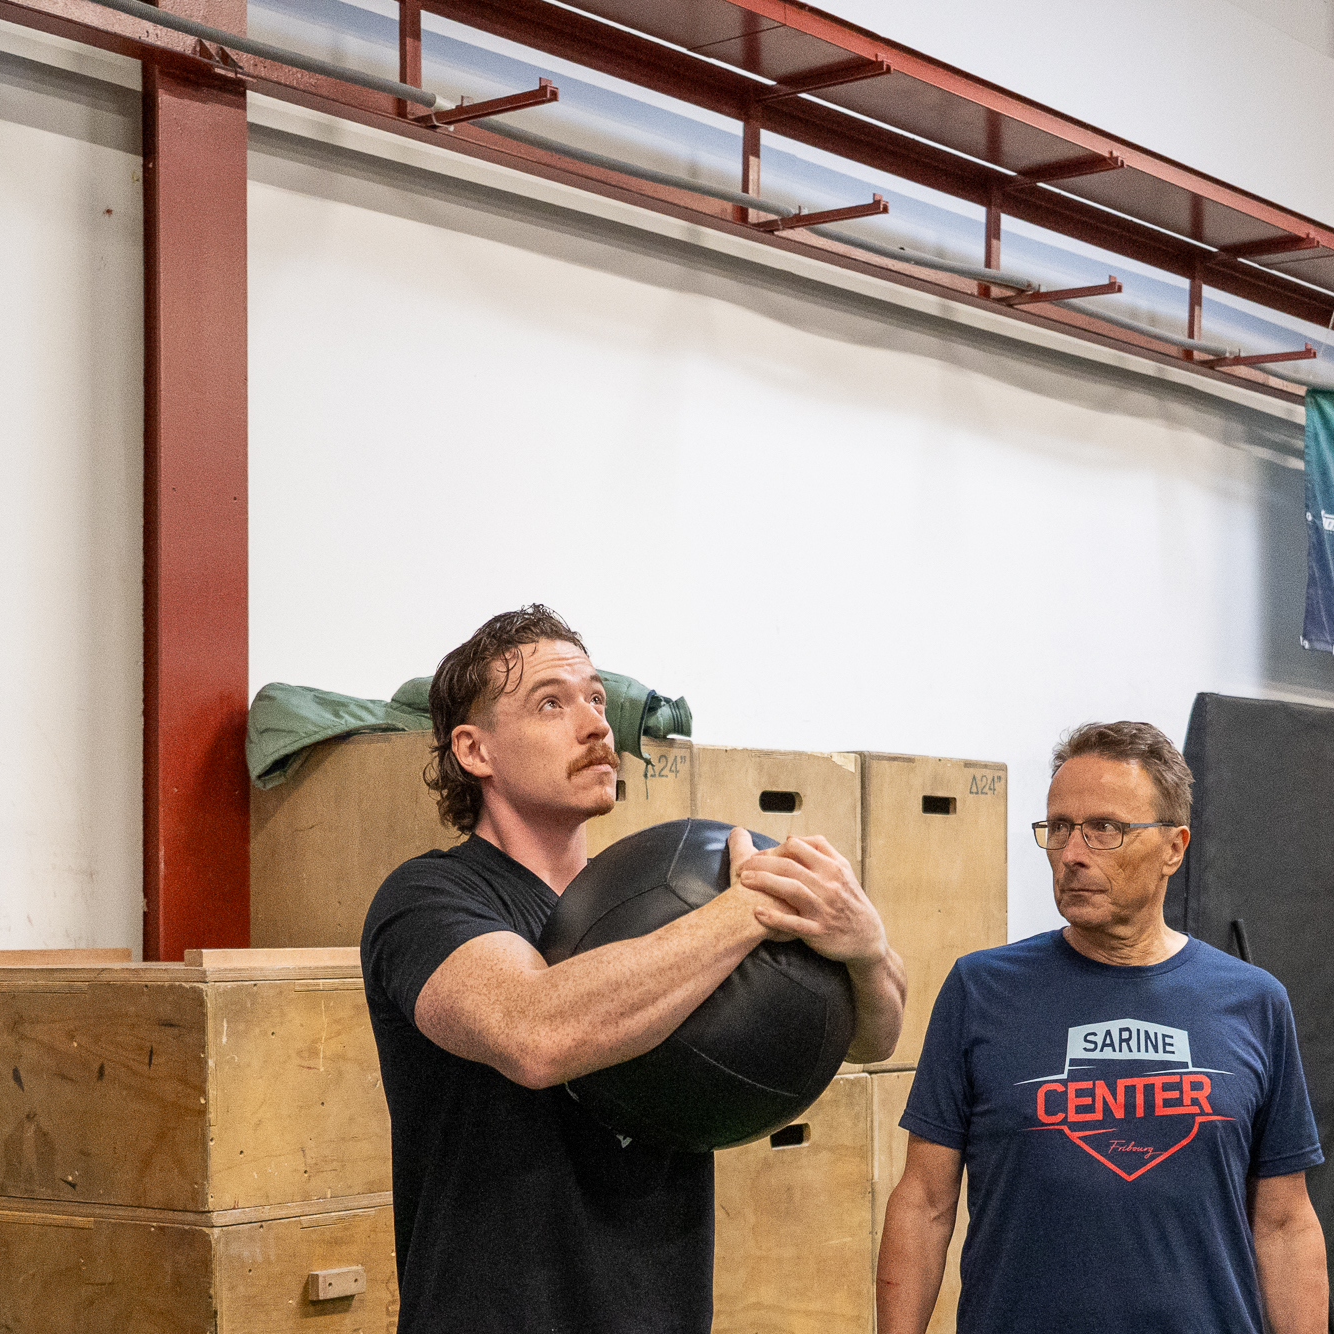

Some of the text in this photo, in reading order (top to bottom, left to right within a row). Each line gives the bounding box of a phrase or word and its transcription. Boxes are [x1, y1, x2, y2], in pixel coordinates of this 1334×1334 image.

[1082, 1027, 1176, 1055] SARINE
[1036, 1074, 1213, 1124] CENTER
[1108, 1140, 1157, 1159] Fribourg
